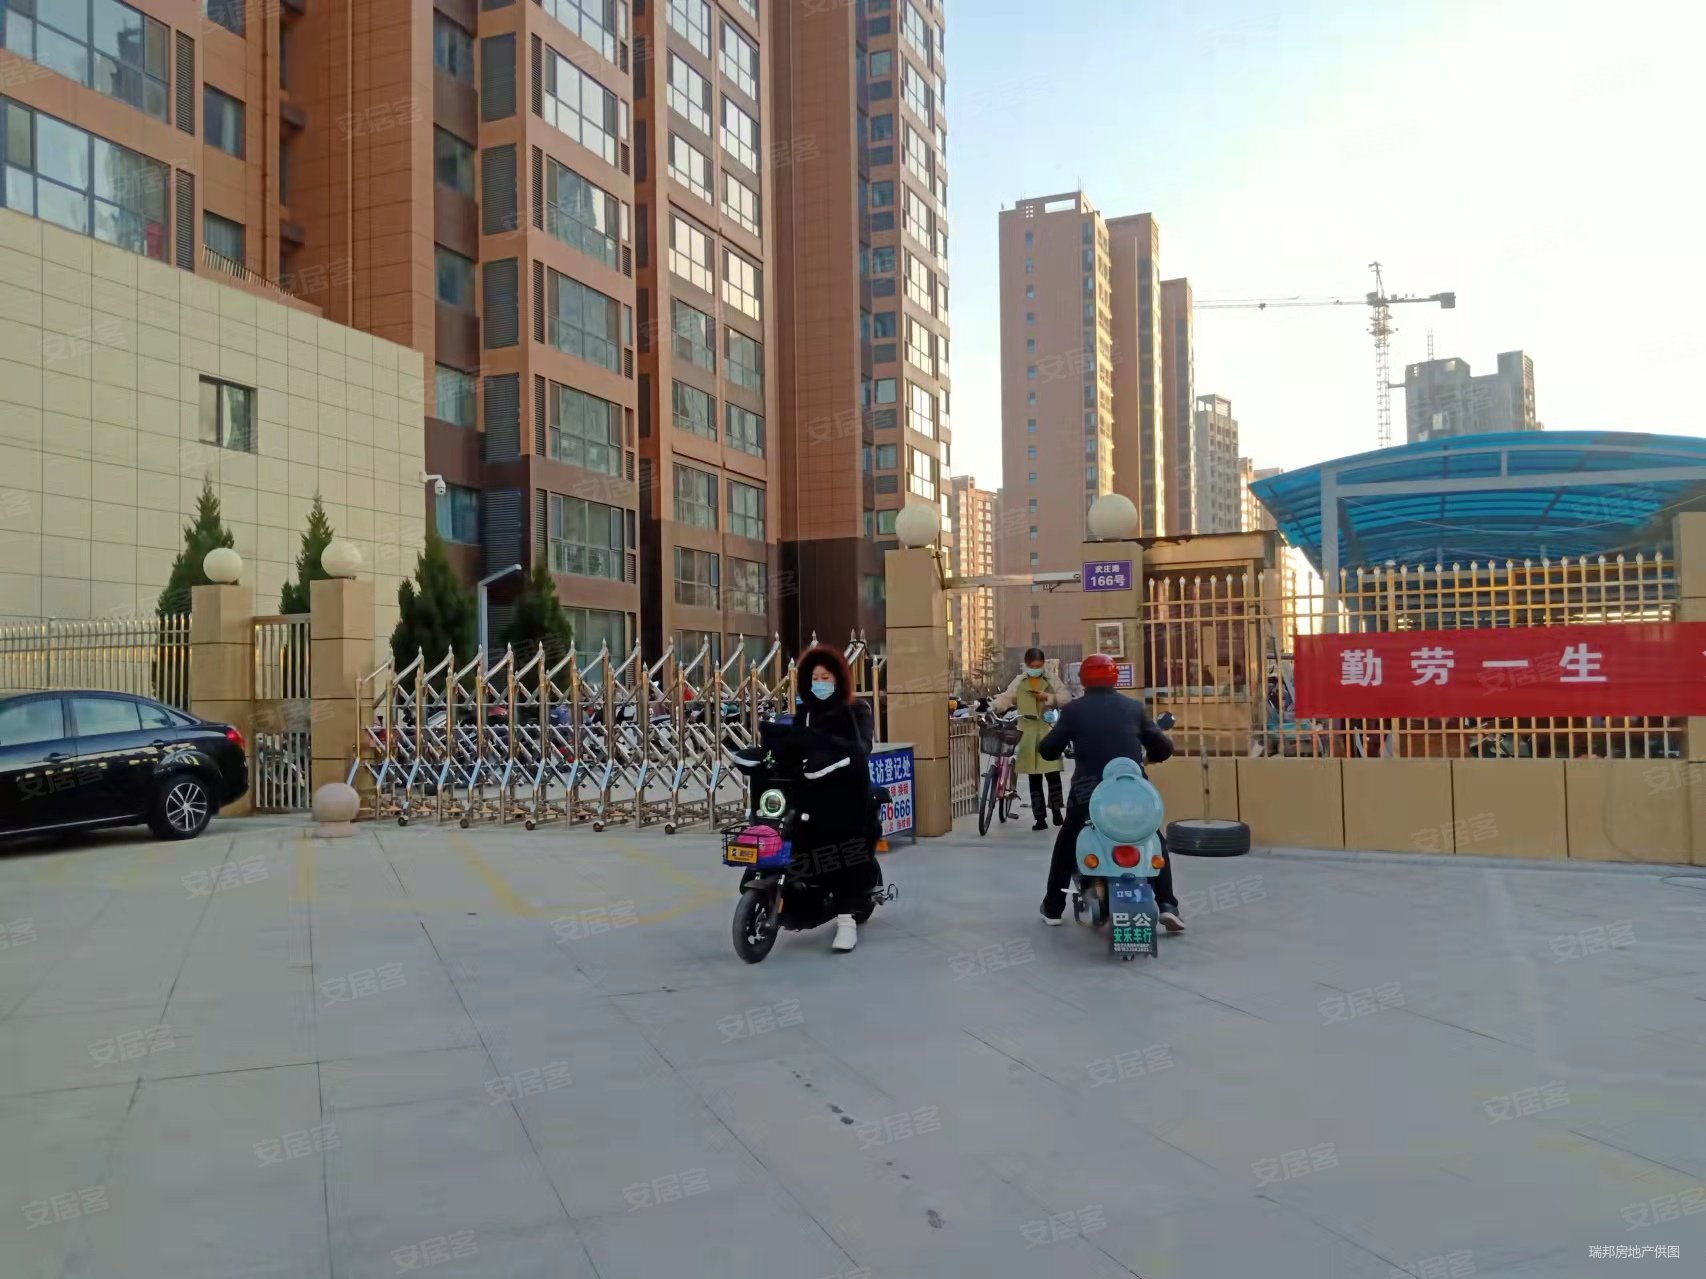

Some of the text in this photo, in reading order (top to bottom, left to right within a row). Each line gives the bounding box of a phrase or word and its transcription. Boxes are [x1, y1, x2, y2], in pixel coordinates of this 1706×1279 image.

[1090, 574, 1126, 587] 166号
[1340, 643, 1607, 686] 勤劳一生
[1112, 912, 1152, 927] 巴公
[1113, 927, 1152, 943] 安乐车行
